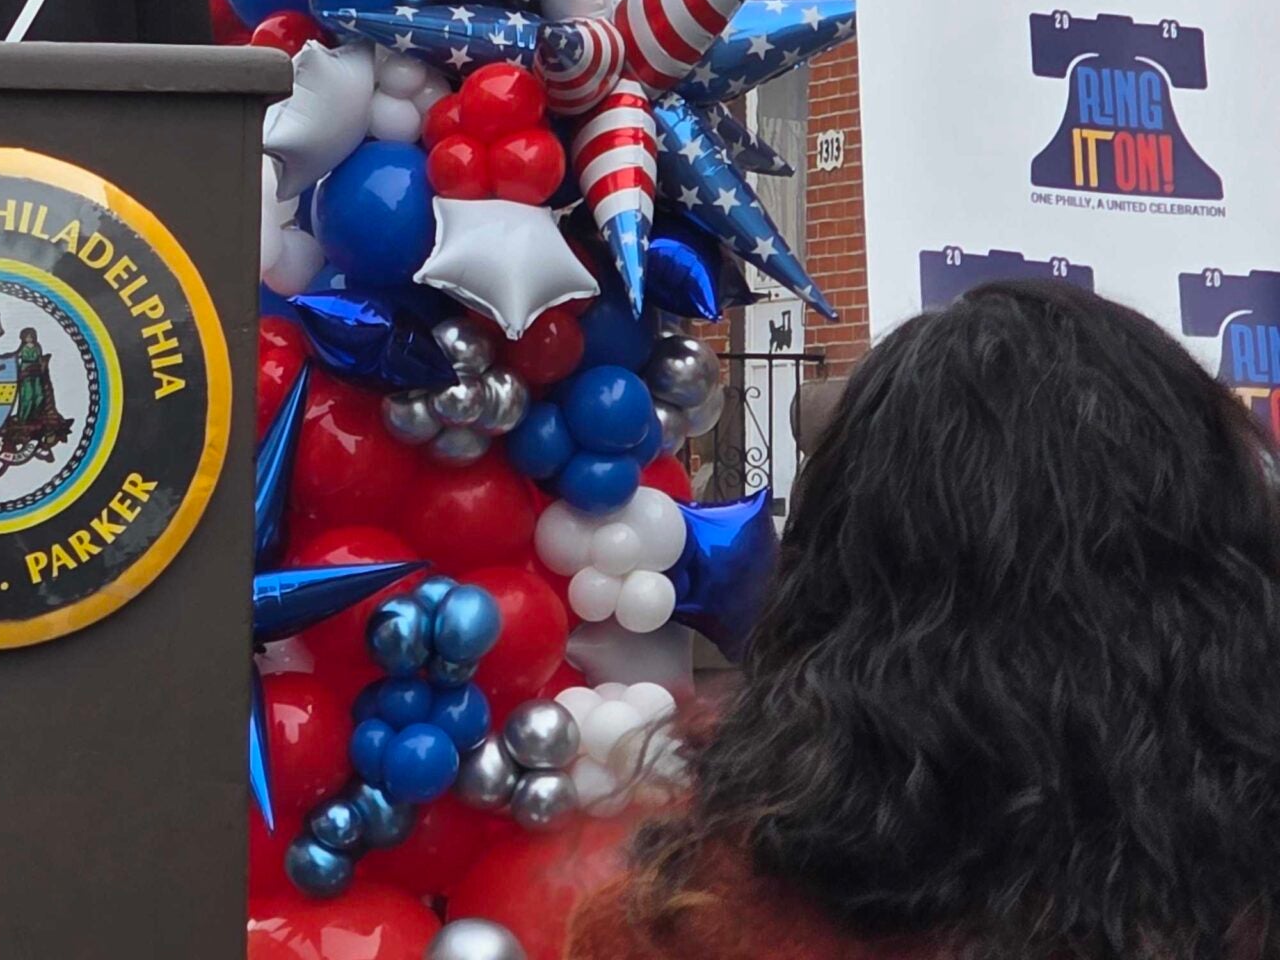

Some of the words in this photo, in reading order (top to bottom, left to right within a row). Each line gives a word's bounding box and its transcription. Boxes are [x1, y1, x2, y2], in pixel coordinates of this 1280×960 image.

[1055, 13, 1069, 29] 20
[1162, 22, 1177, 38] 26
[1076, 66, 1163, 130] RING
[820, 137, 841, 163] 1313
[1072, 128, 1115, 187] IT
[1114, 131, 1175, 193] ON!
[1031, 192, 1054, 205] ONE
[1055, 194, 1096, 211] PHILLY,
[1097, 198, 1105, 210] A
[1107, 200, 1147, 213] UNITED
[1149, 203, 1227, 218] CELEBRATION
[946, 249, 962, 266] 20
[1052, 260, 1068, 277] 26
[1205, 271, 1221, 287] 20
[24, 472, 158, 584] PARKER
